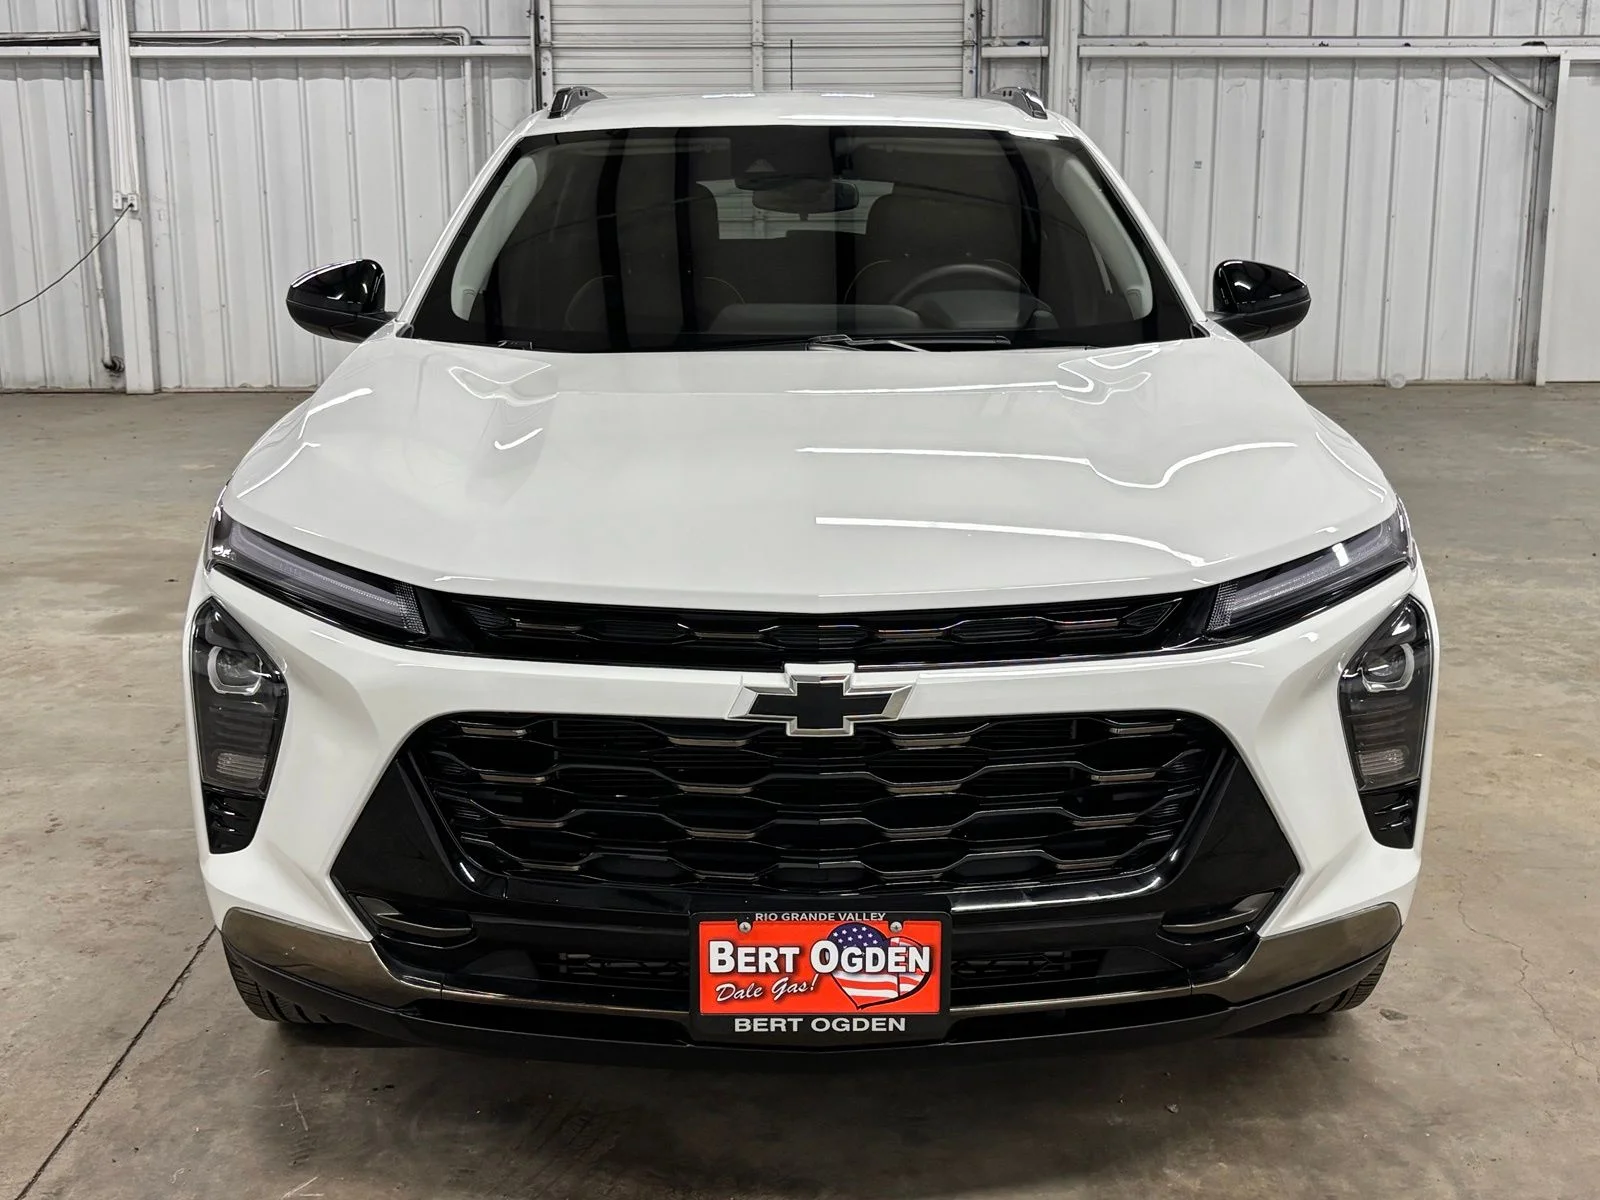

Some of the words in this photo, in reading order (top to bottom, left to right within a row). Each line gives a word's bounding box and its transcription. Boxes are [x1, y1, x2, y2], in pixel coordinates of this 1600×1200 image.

[755, 912, 780, 922] RIO
[781, 912, 836, 922] GRANDE
[837, 912, 886, 922] VALLEY
[708, 939, 801, 974] BERT
[809, 939, 931, 975] OGDEN
[715, 982, 764, 1002] Dale
[771, 974, 819, 1001] Gas!
[734, 1017, 804, 1033] BERT
[810, 1017, 906, 1033] OGDEN
